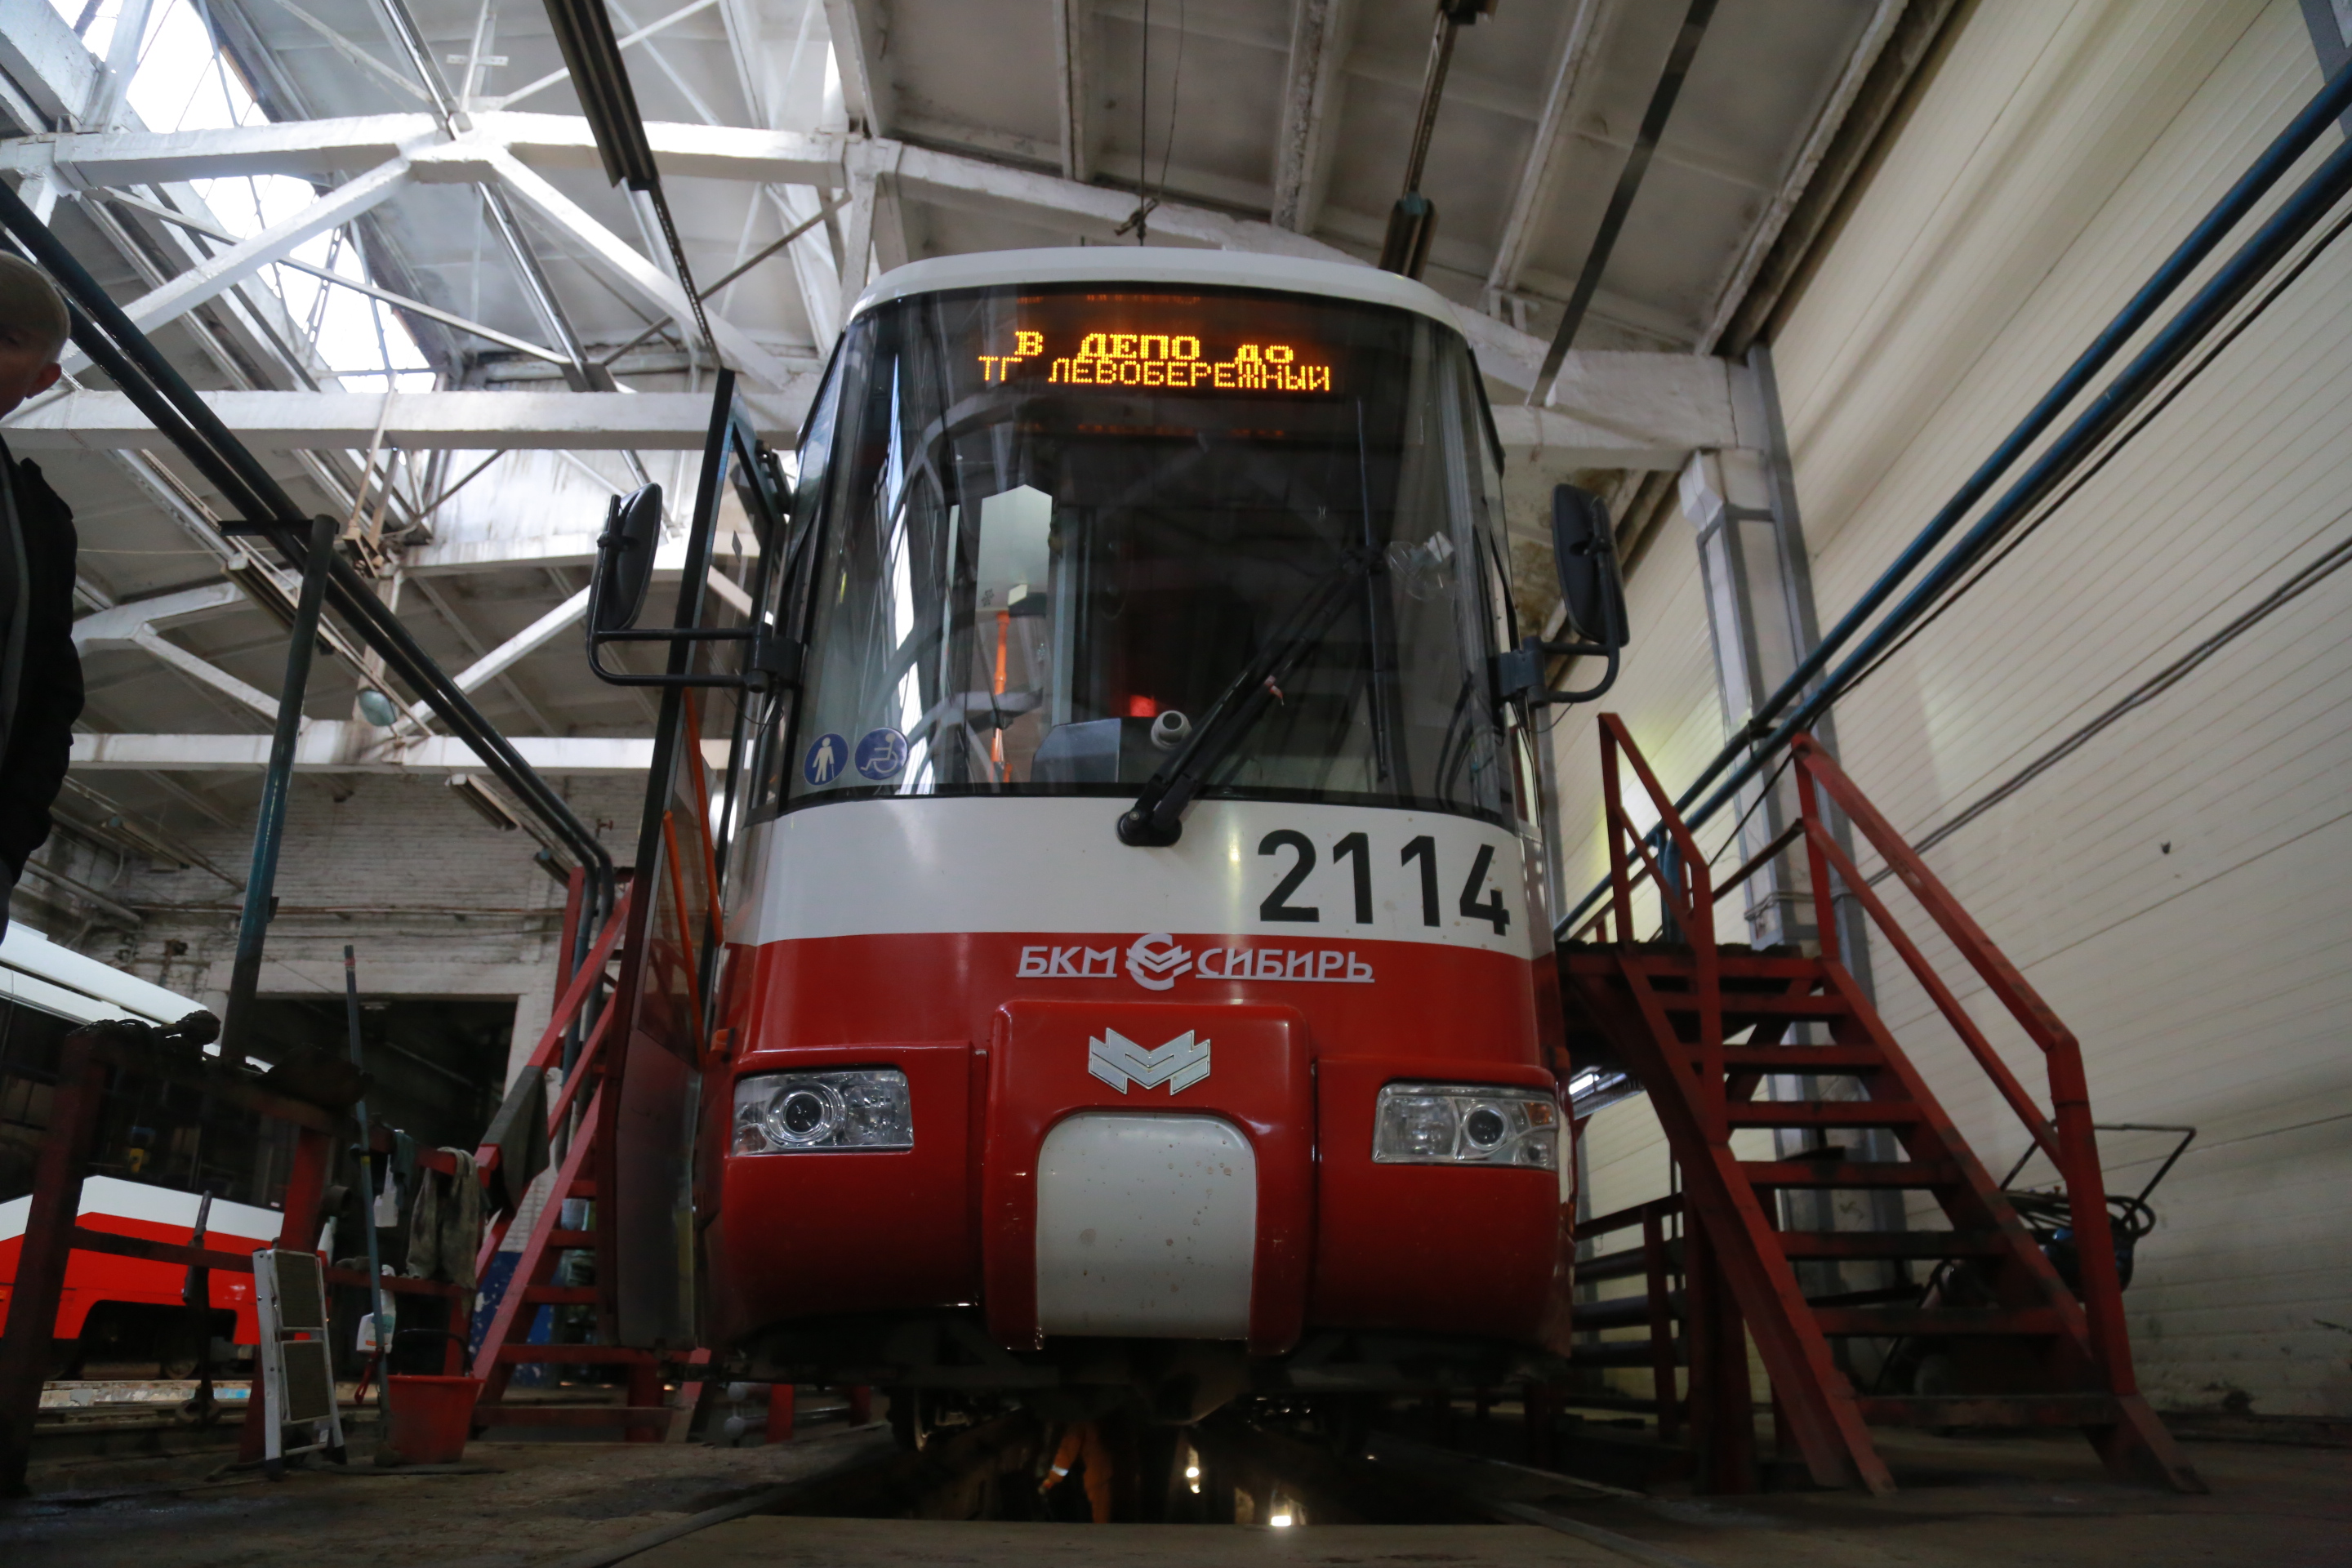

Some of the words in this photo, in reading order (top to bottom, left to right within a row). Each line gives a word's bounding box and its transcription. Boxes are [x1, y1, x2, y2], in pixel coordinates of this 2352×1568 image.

[1014, 331, 1043, 356] В
[1076, 332, 1200, 364] ДЕПО
[1234, 344, 1294, 366] ДО
[1048, 357, 1330, 391] ЛЕВОБЕРЕЖНЫЙ
[1257, 828, 1510, 937] 2114
[1016, 945, 1118, 978] БКМ
[1196, 947, 1375, 983] СИБИРЬ
